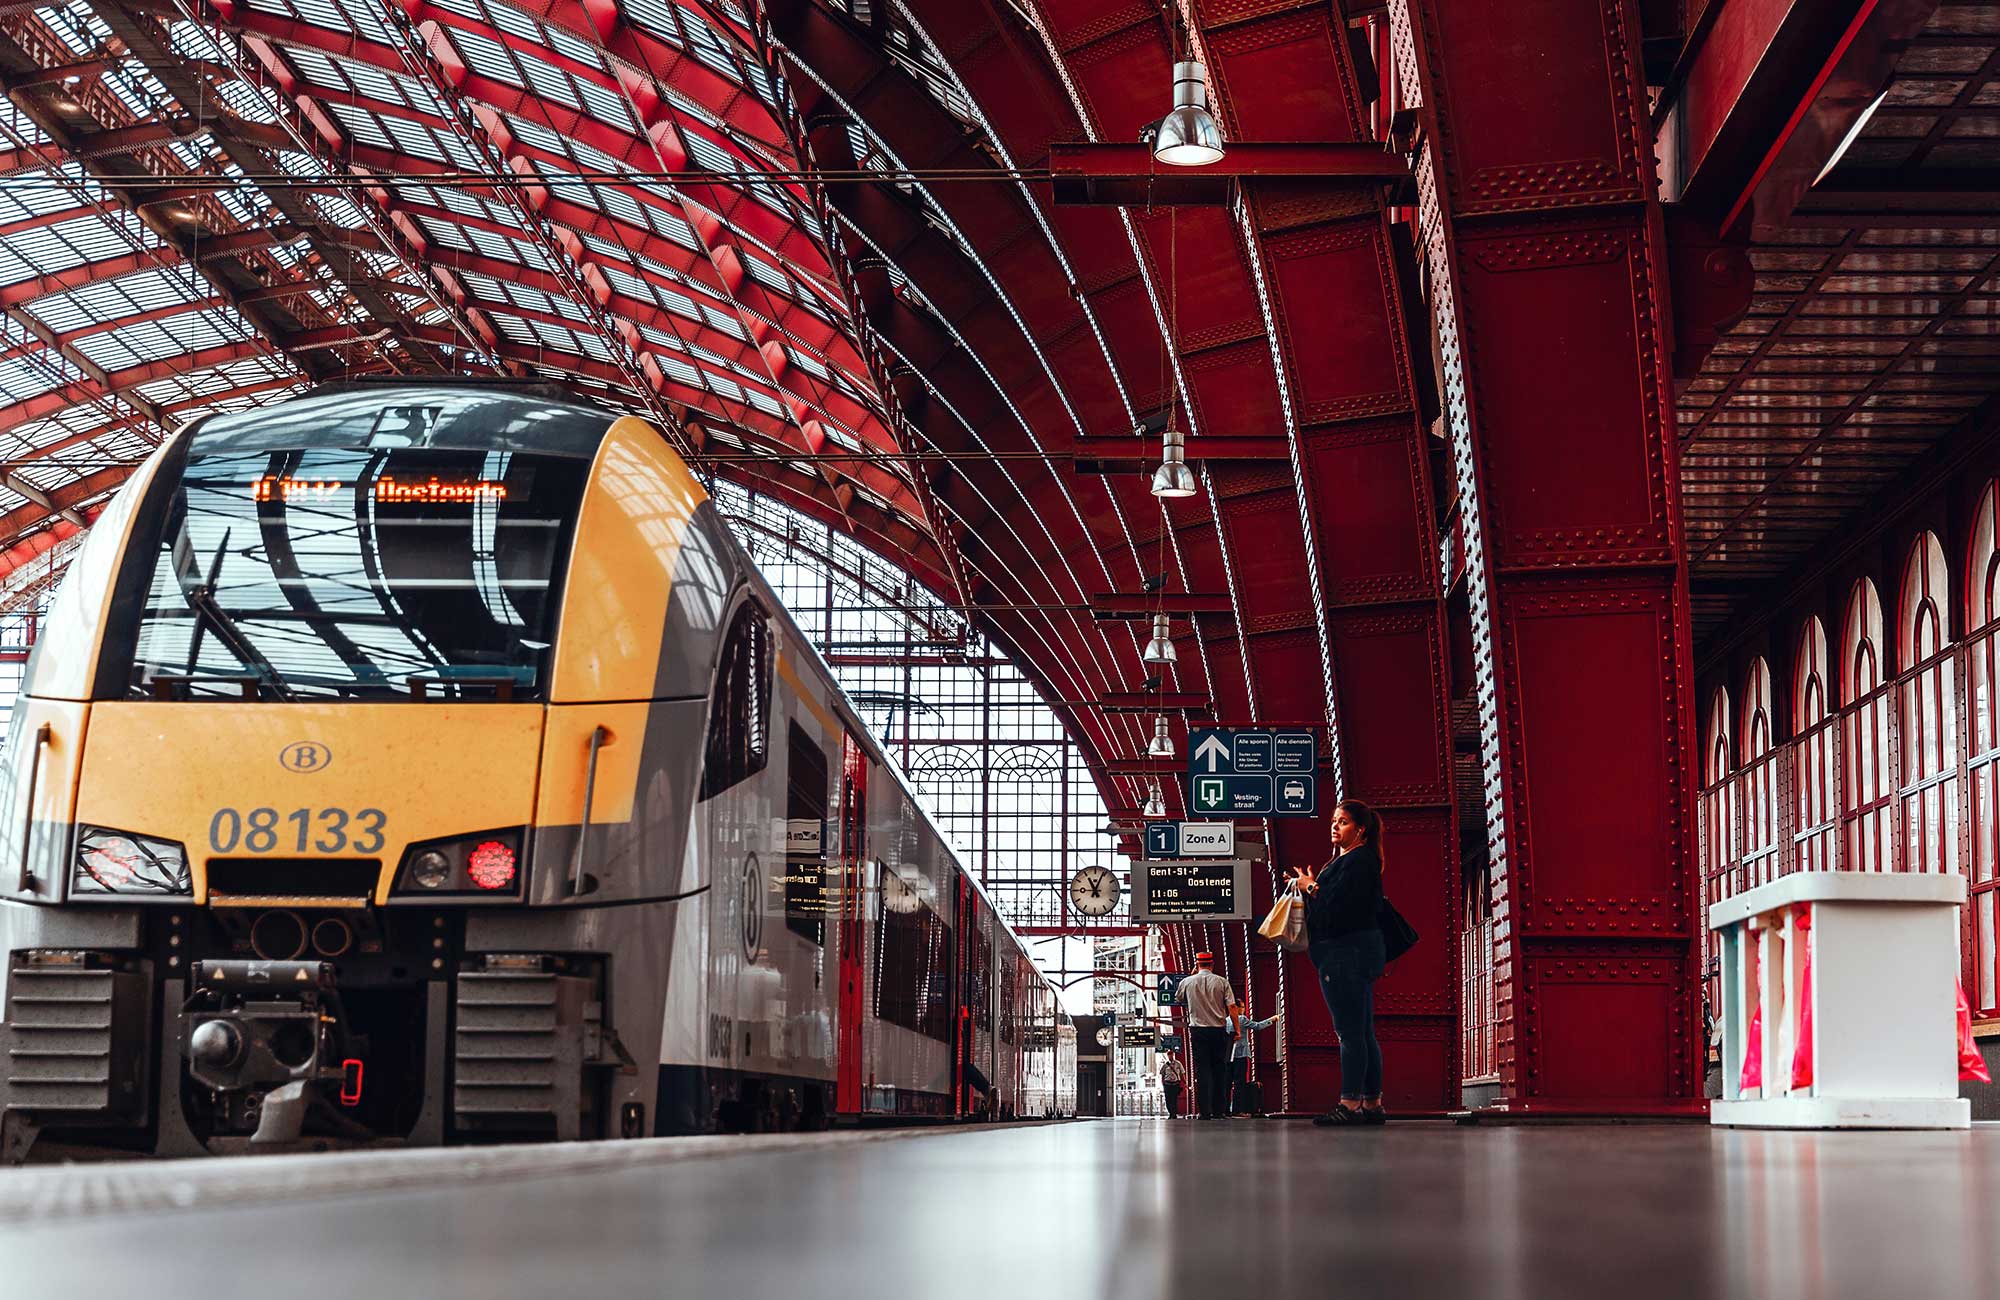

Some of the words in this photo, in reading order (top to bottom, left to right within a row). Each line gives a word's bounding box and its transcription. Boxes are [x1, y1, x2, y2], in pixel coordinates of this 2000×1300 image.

[293, 746, 317, 768] B
[1233, 794, 1263, 802] Vesting-
[209, 807, 387, 853] 08133
[1157, 832, 1166, 849] 1
[1186, 833, 1215, 844] Zone
[1218, 833, 1227, 844] A
[1150, 867, 1199, 876] Gent-St-P
[1188, 877, 1231, 887] Oostende
[1151, 889, 1179, 898] 11:06
[1221, 888, 1232, 897] IC
